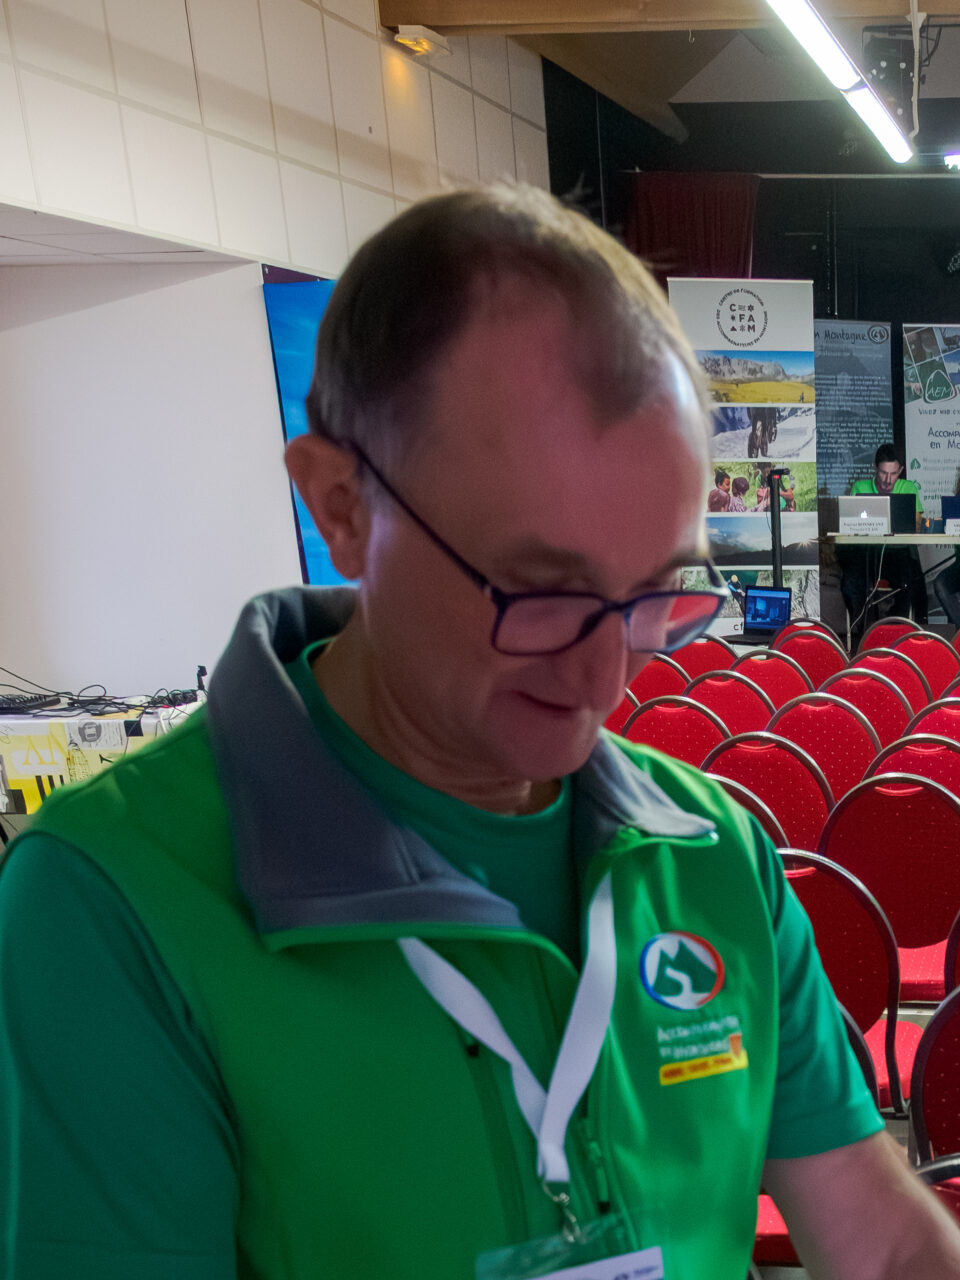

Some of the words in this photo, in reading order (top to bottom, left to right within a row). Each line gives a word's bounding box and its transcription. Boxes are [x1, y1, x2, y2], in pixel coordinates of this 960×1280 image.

[824, 330, 868, 344] Montagne
[926, 386, 954, 398] AEM
[930, 441, 941, 449] en
